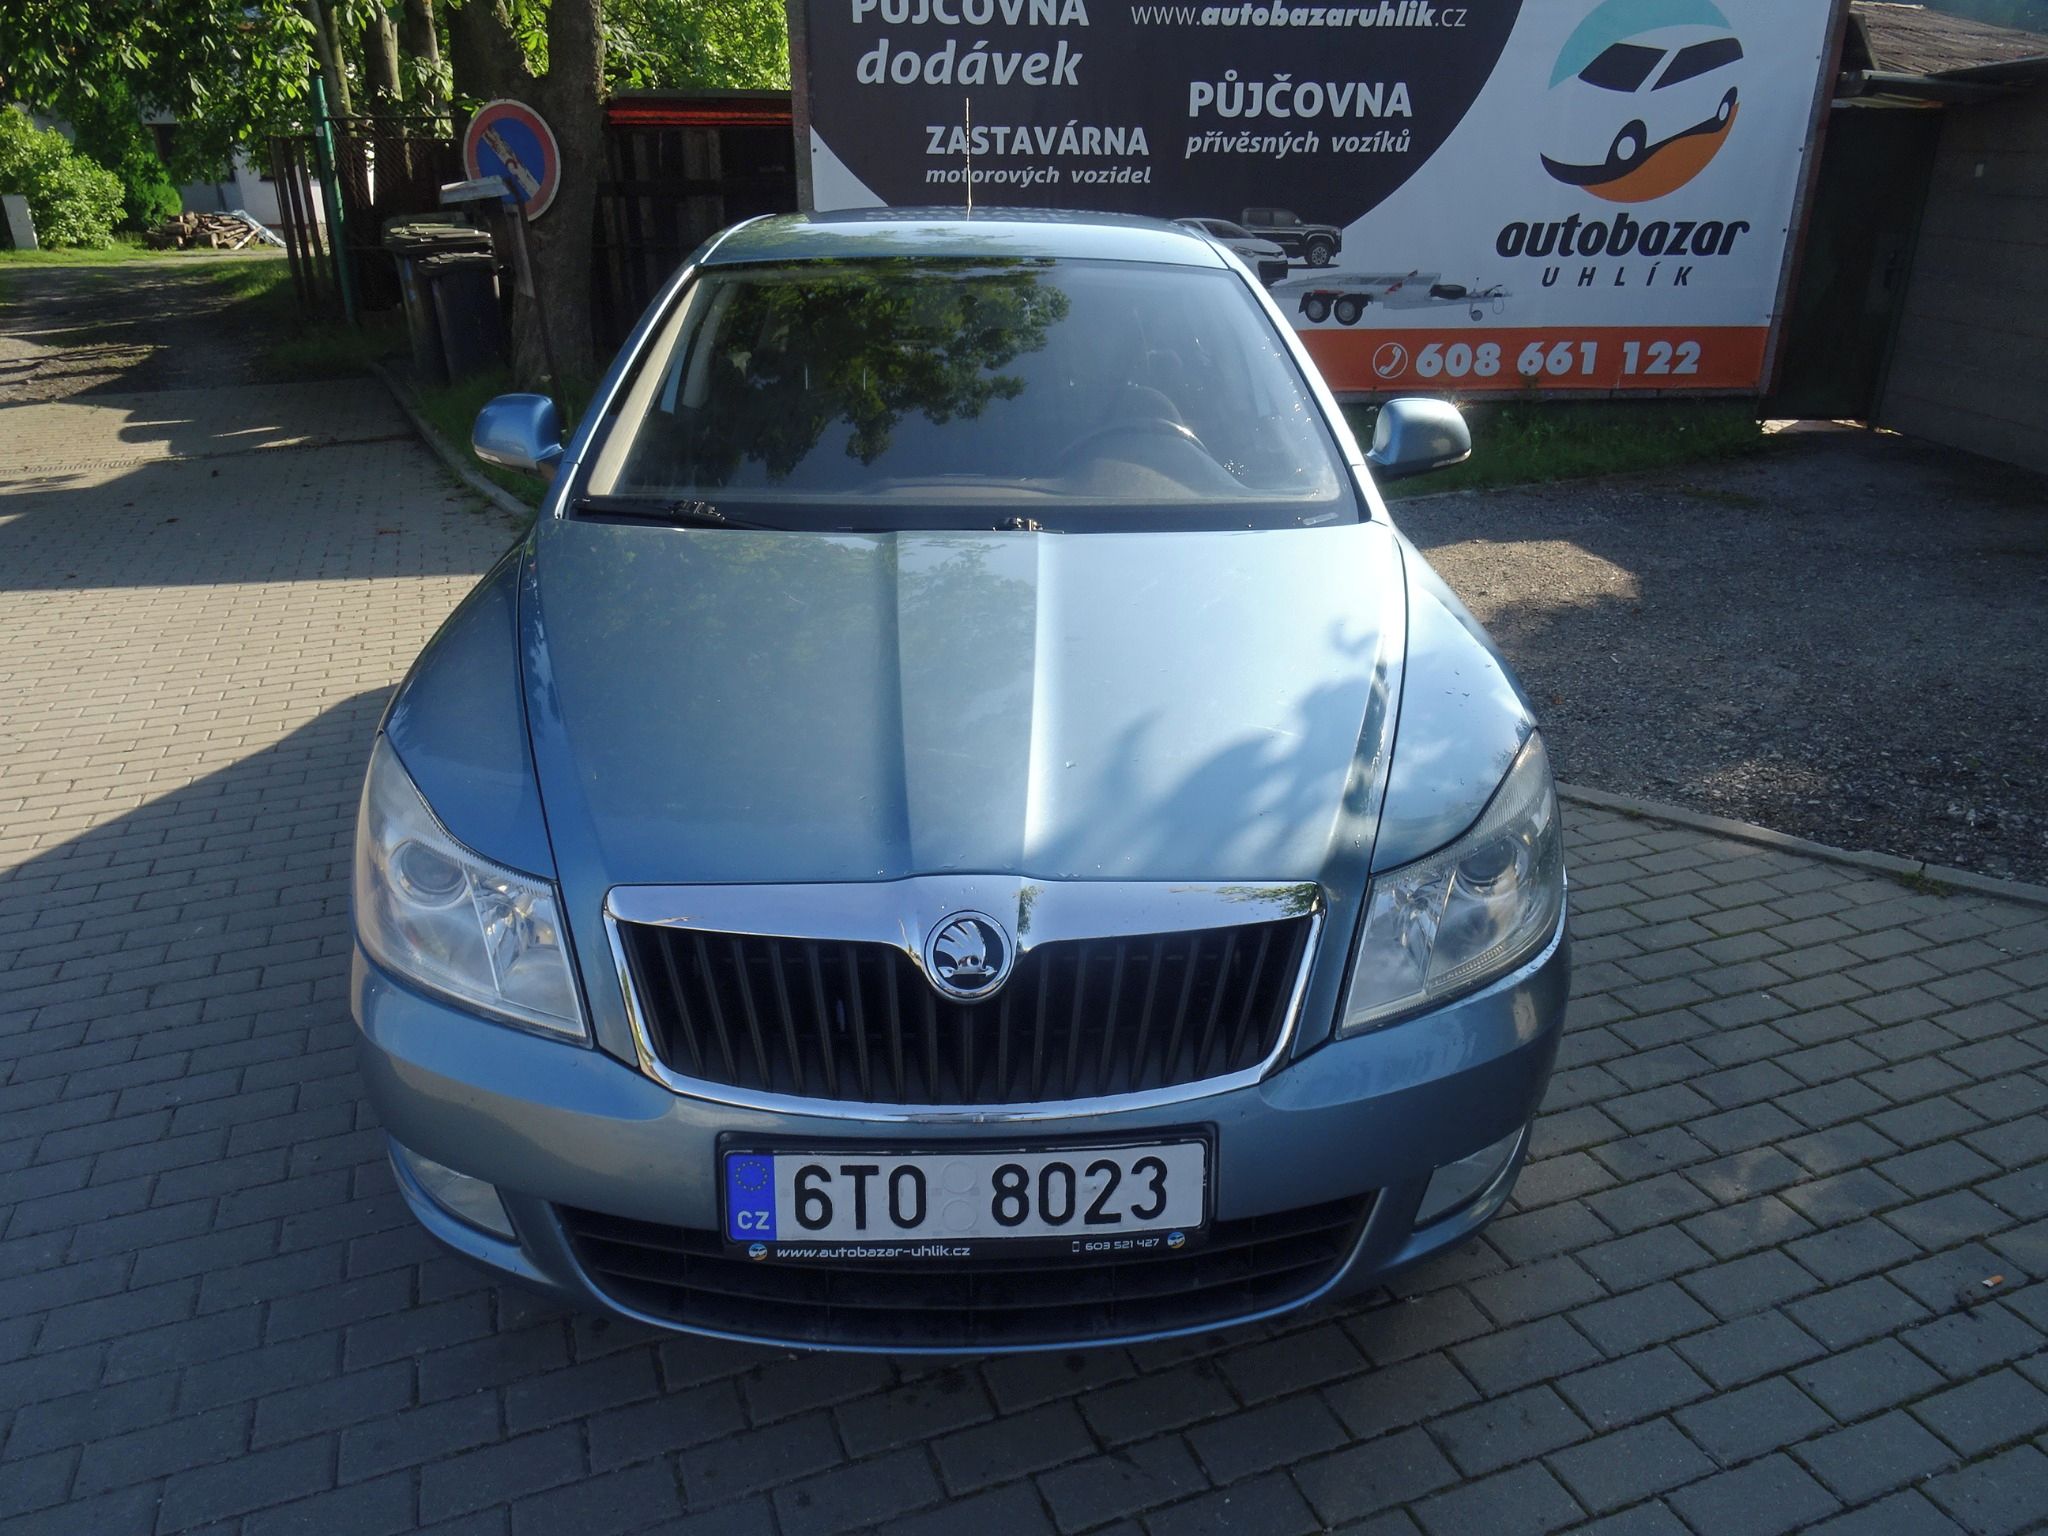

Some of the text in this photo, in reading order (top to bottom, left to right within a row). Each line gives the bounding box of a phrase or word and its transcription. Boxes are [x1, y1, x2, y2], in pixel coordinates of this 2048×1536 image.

[1131, 0, 1468, 27] www.autobazaruhlik.cz
[856, 38, 1084, 86] dodávek
[1189, 69, 1413, 118] PŮJČOVNA
[925, 120, 1150, 156] ZASTAVÁRNA
[1185, 128, 1411, 160] přívěsných vozíků
[925, 166, 1151, 188] motorových vozidel
[1496, 213, 1751, 258] autobazar
[1541, 262, 1694, 288] UHLÍK
[1415, 341, 1703, 377] 608 661 122
[793, 1155, 1169, 1231] 6T0 8023
[737, 1210, 770, 1231] CZ
[776, 1244, 971, 1259] www.autobazar-uhlik.cz
[1085, 1238, 1160, 1251] 603 521 427
